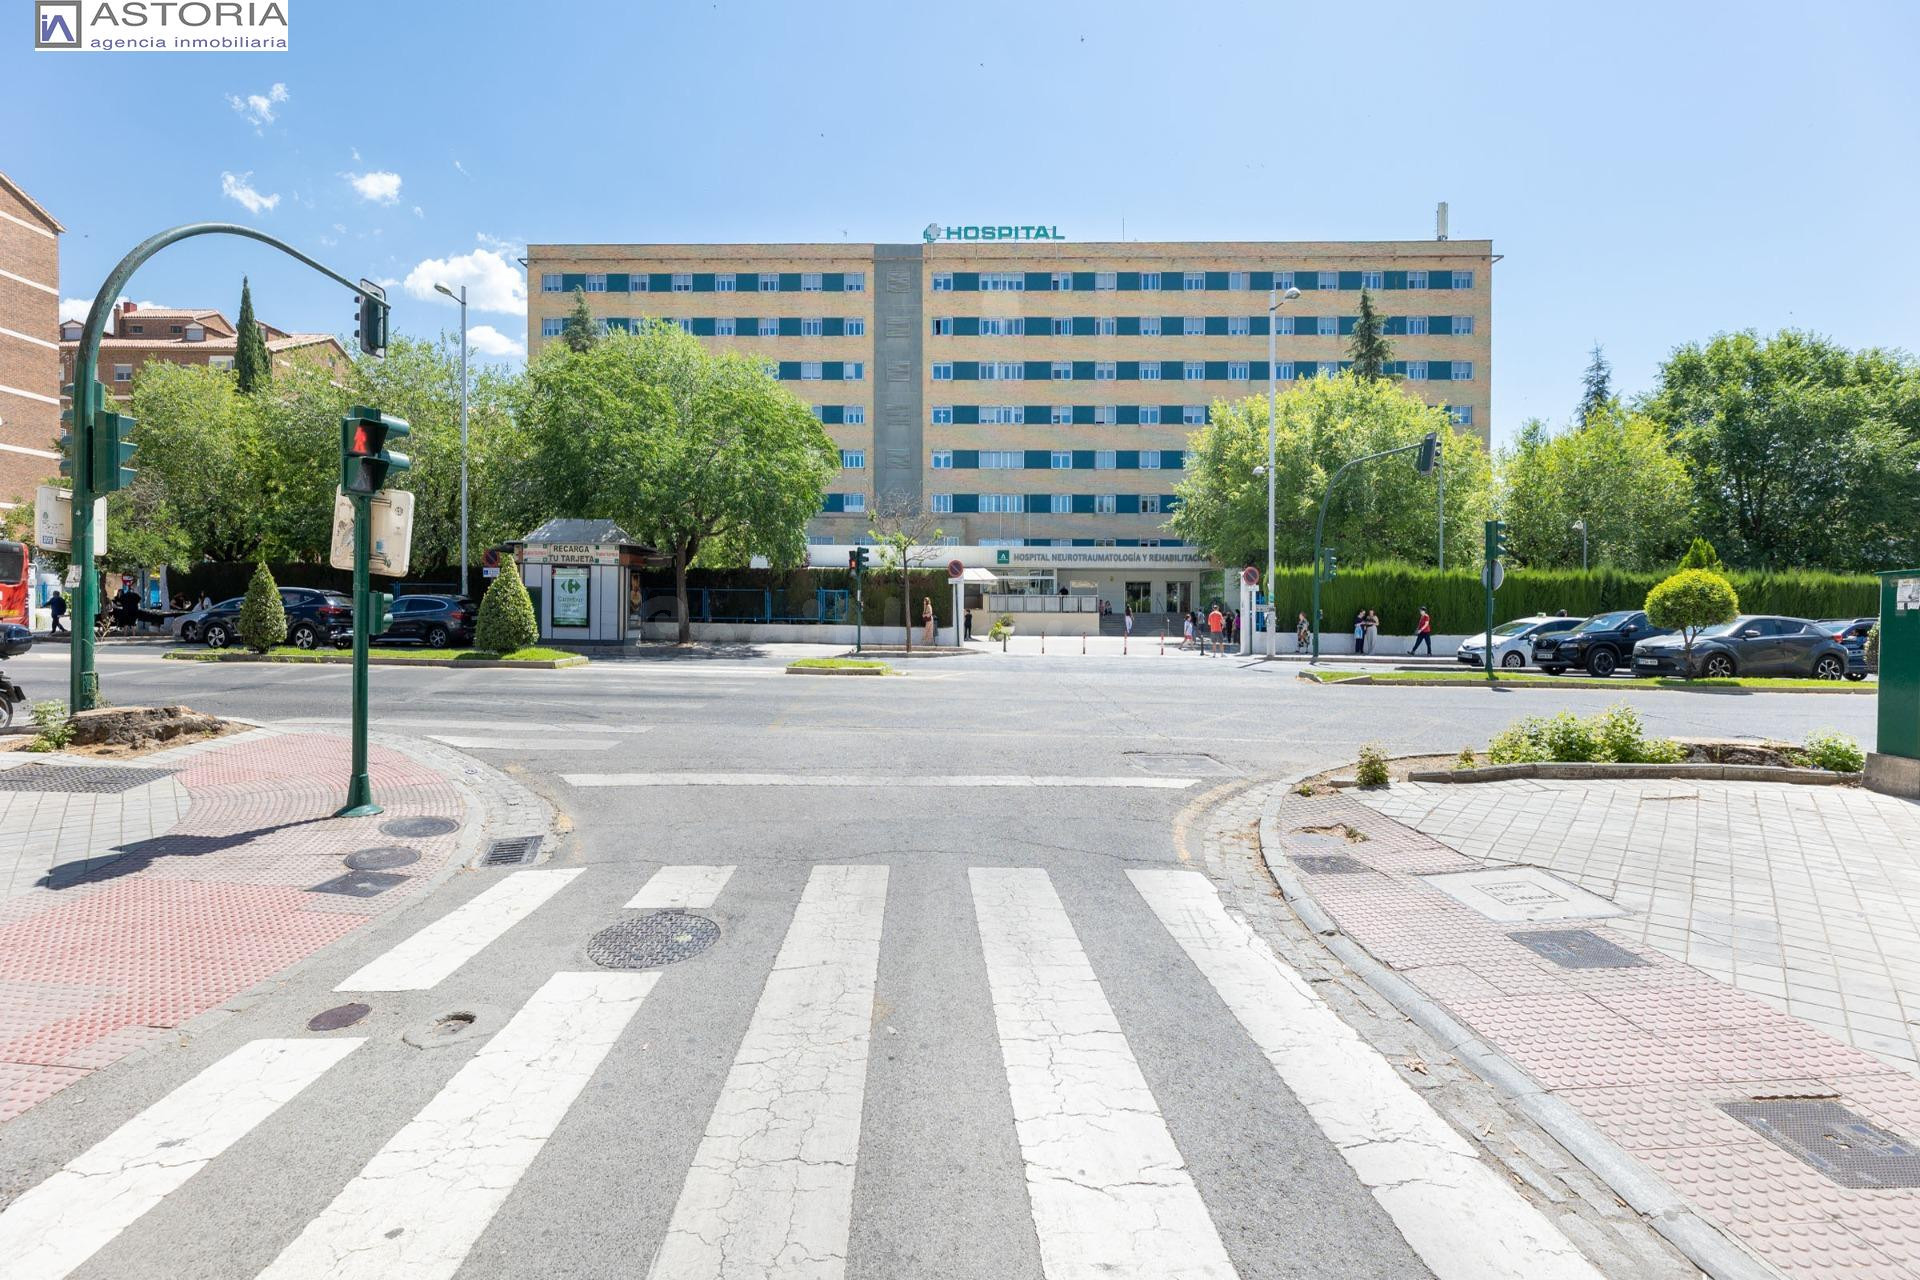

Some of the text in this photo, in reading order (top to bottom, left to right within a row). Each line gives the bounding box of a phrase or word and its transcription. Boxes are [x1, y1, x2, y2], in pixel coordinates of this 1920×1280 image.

[946, 225, 1066, 240] HOSPITAL
[553, 545, 589, 553] RECARGA
[1013, 553, 1049, 561] HOSPITAL
[1051, 552, 1140, 561] NEUROTRAUMATOLOGÍA
[1142, 553, 1148, 562] Y
